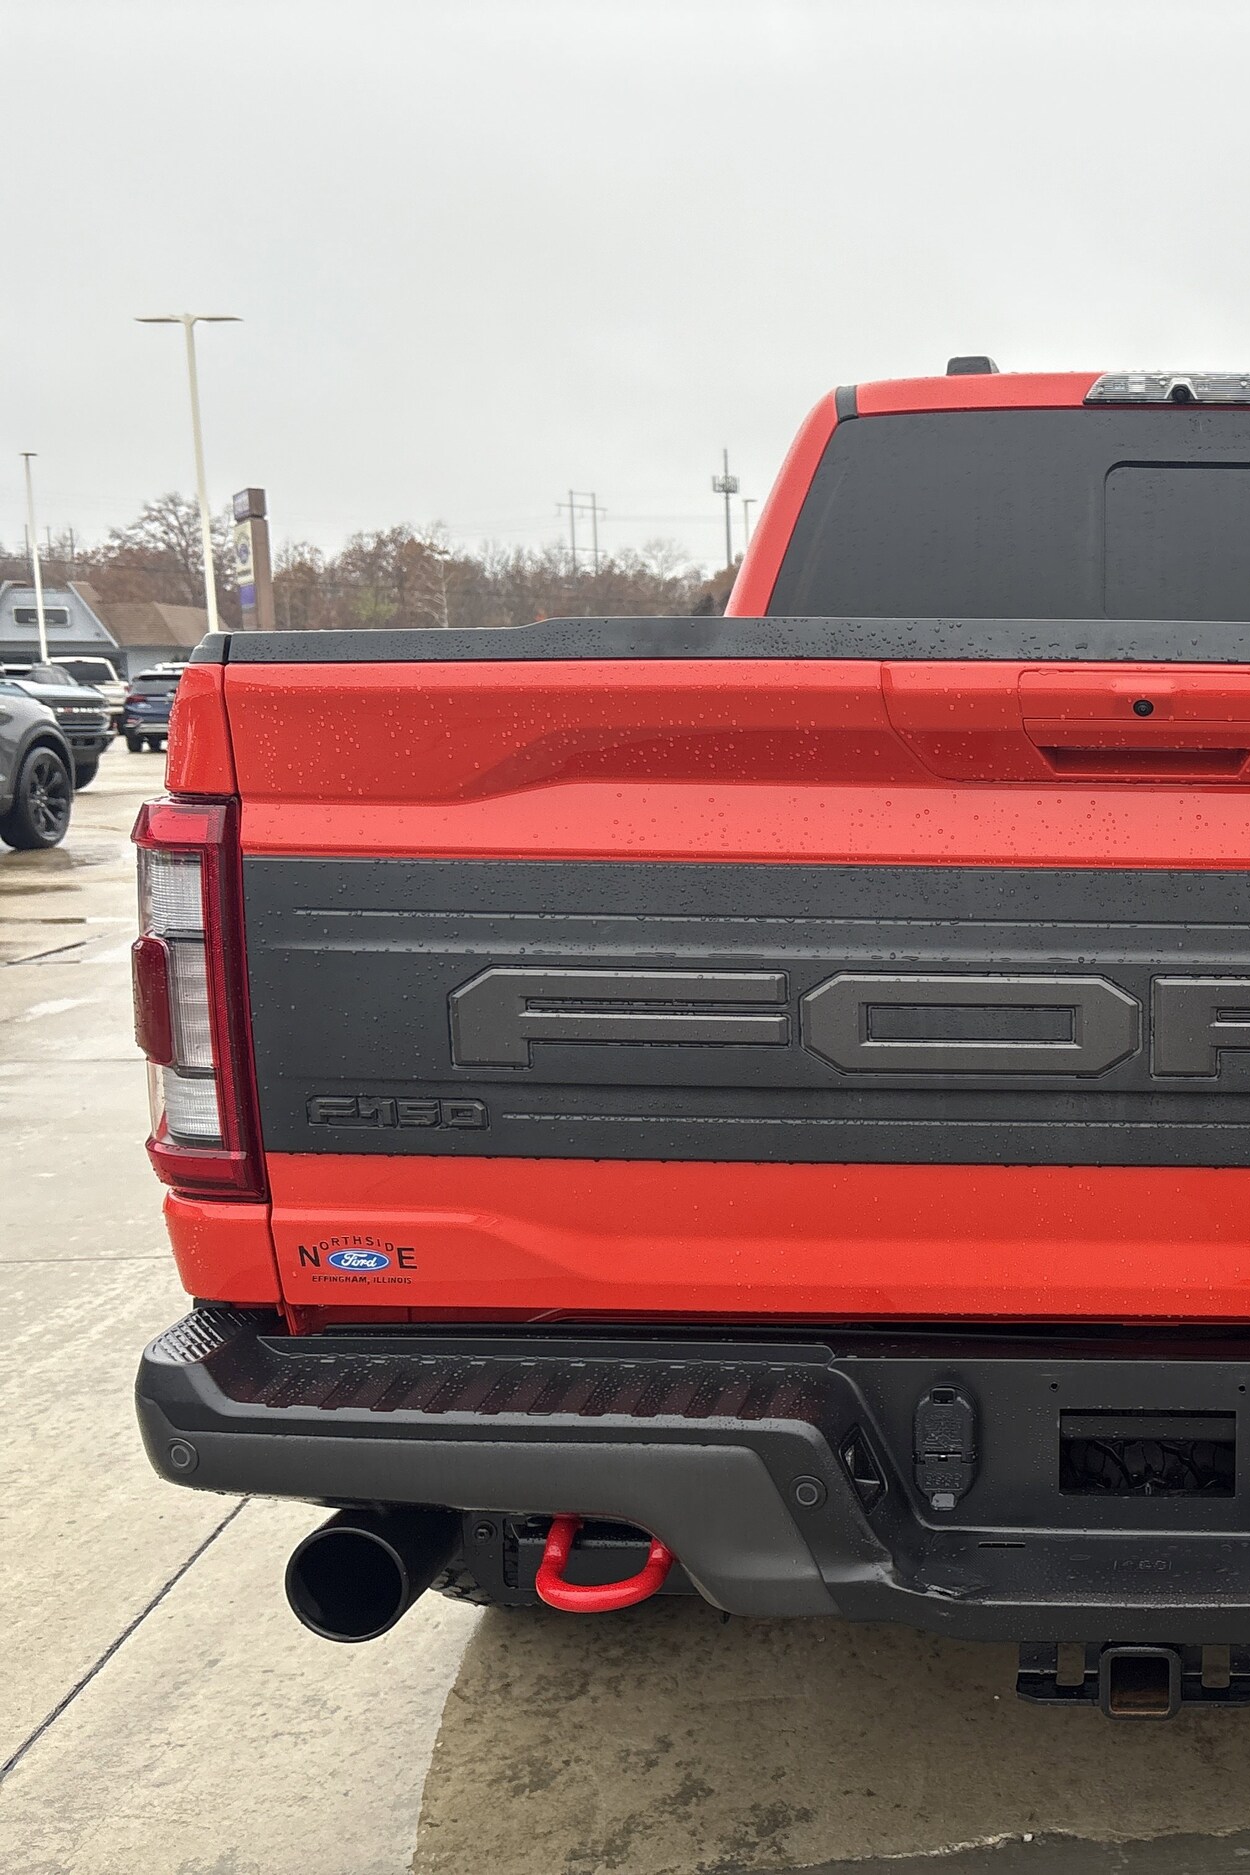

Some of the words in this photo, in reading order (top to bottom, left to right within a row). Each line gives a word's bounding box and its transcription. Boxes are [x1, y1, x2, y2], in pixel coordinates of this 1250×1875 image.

[306, 1095, 491, 1130] F-150
[298, 1235, 417, 1270] NORTHSIDE
[341, 1252, 377, 1268] Ford
[311, 1275, 370, 1285] EFFINGHAM,
[373, 1276, 412, 1285] ILLINOIS
